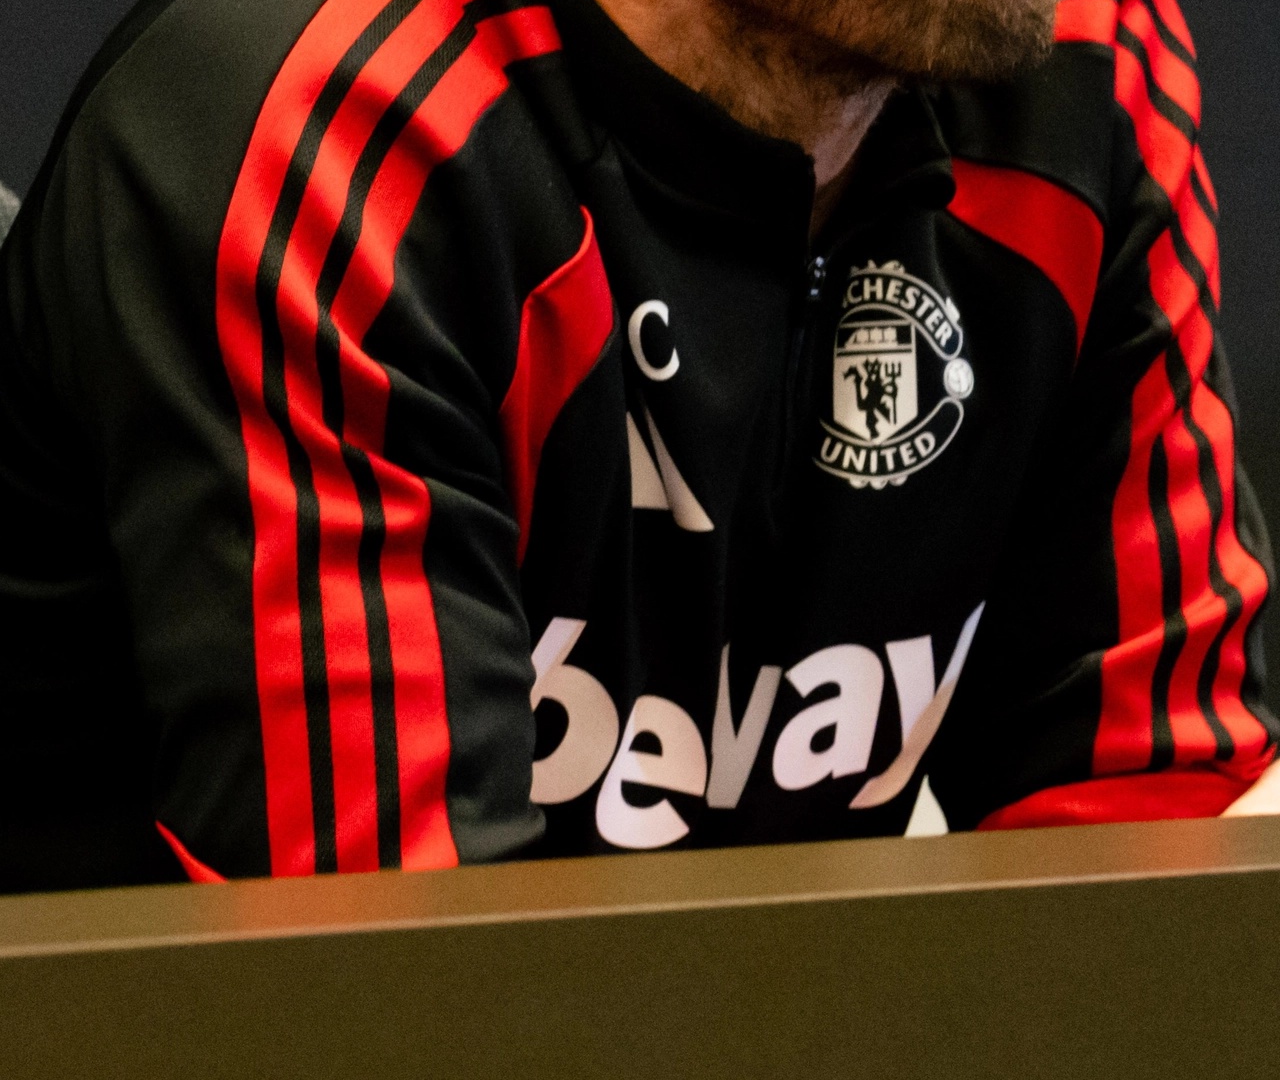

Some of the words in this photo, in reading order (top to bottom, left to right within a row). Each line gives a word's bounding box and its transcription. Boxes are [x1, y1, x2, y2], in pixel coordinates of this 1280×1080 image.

[627, 298, 681, 382] C
[844, 276, 954, 348] CHESTER
[821, 431, 937, 474] UNITED
